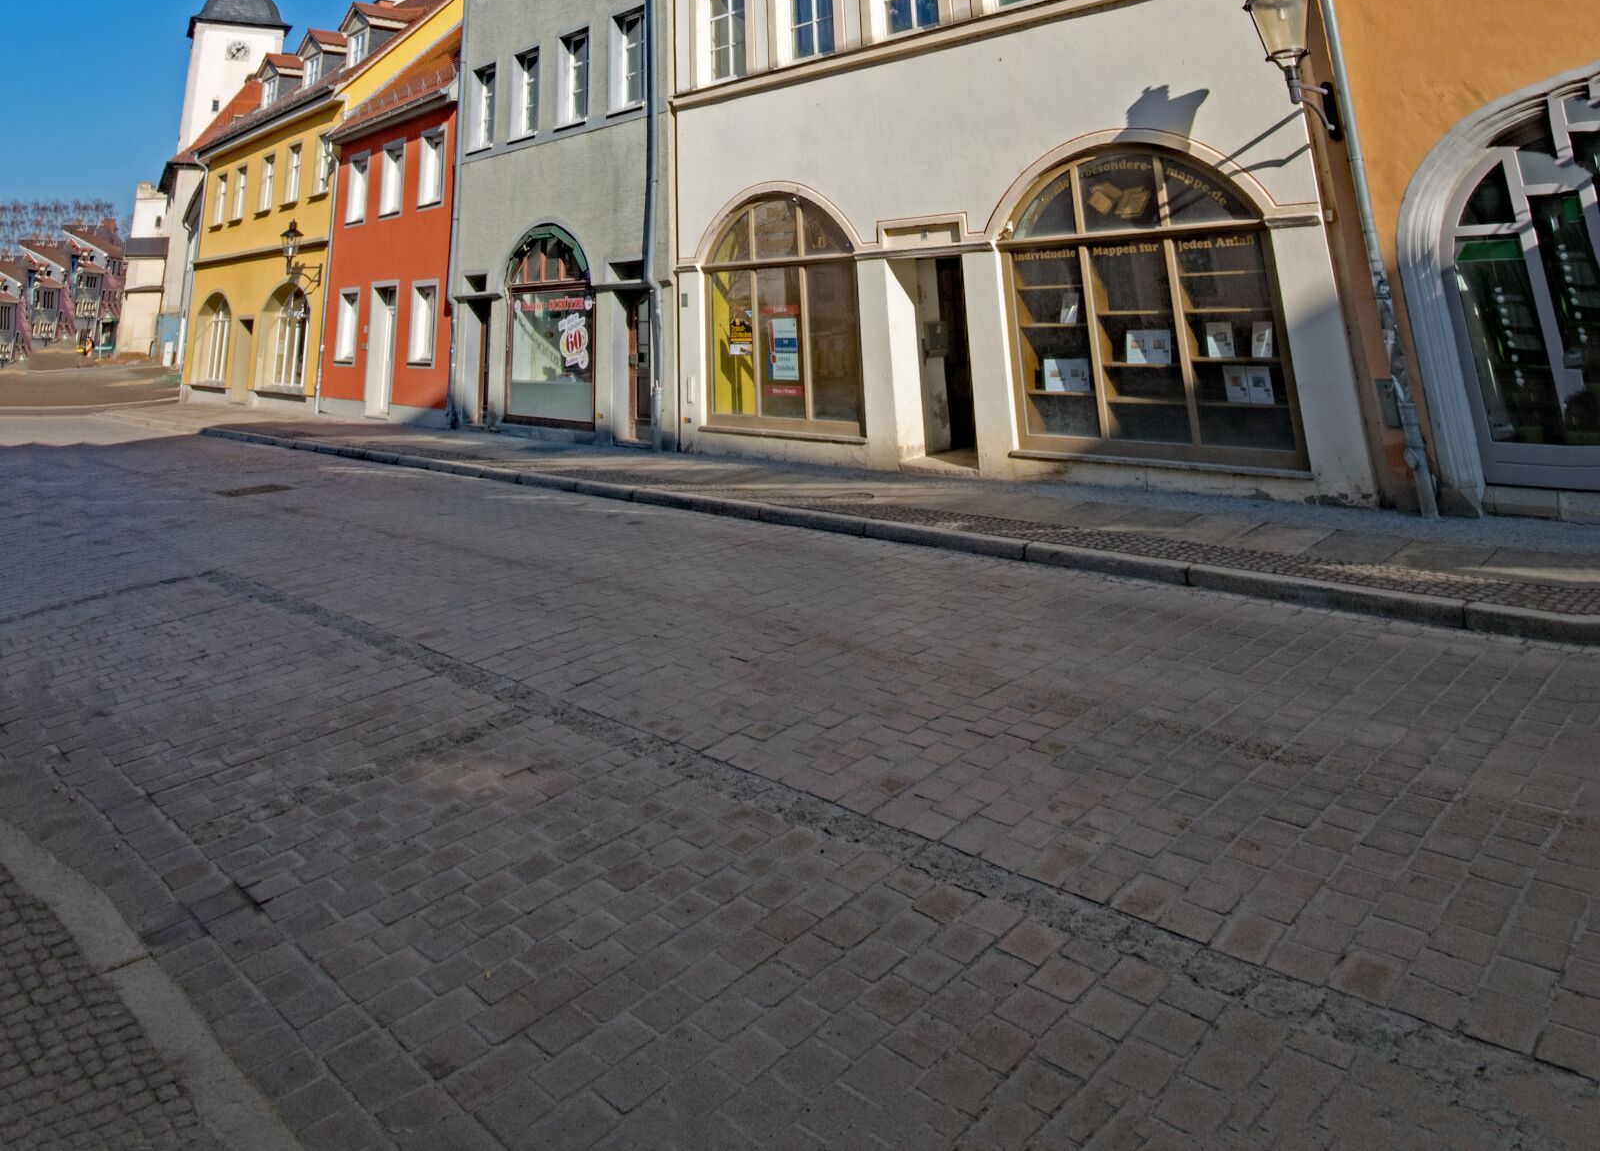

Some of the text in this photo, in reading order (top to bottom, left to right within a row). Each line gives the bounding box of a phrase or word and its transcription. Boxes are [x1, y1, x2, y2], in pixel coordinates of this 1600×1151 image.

[1167, 168, 1227, 206] mappe.de
[1014, 249, 1076, 261] individuelle
[1093, 245, 1136, 256] Mappen
[1178, 240, 1212, 252] jeden
